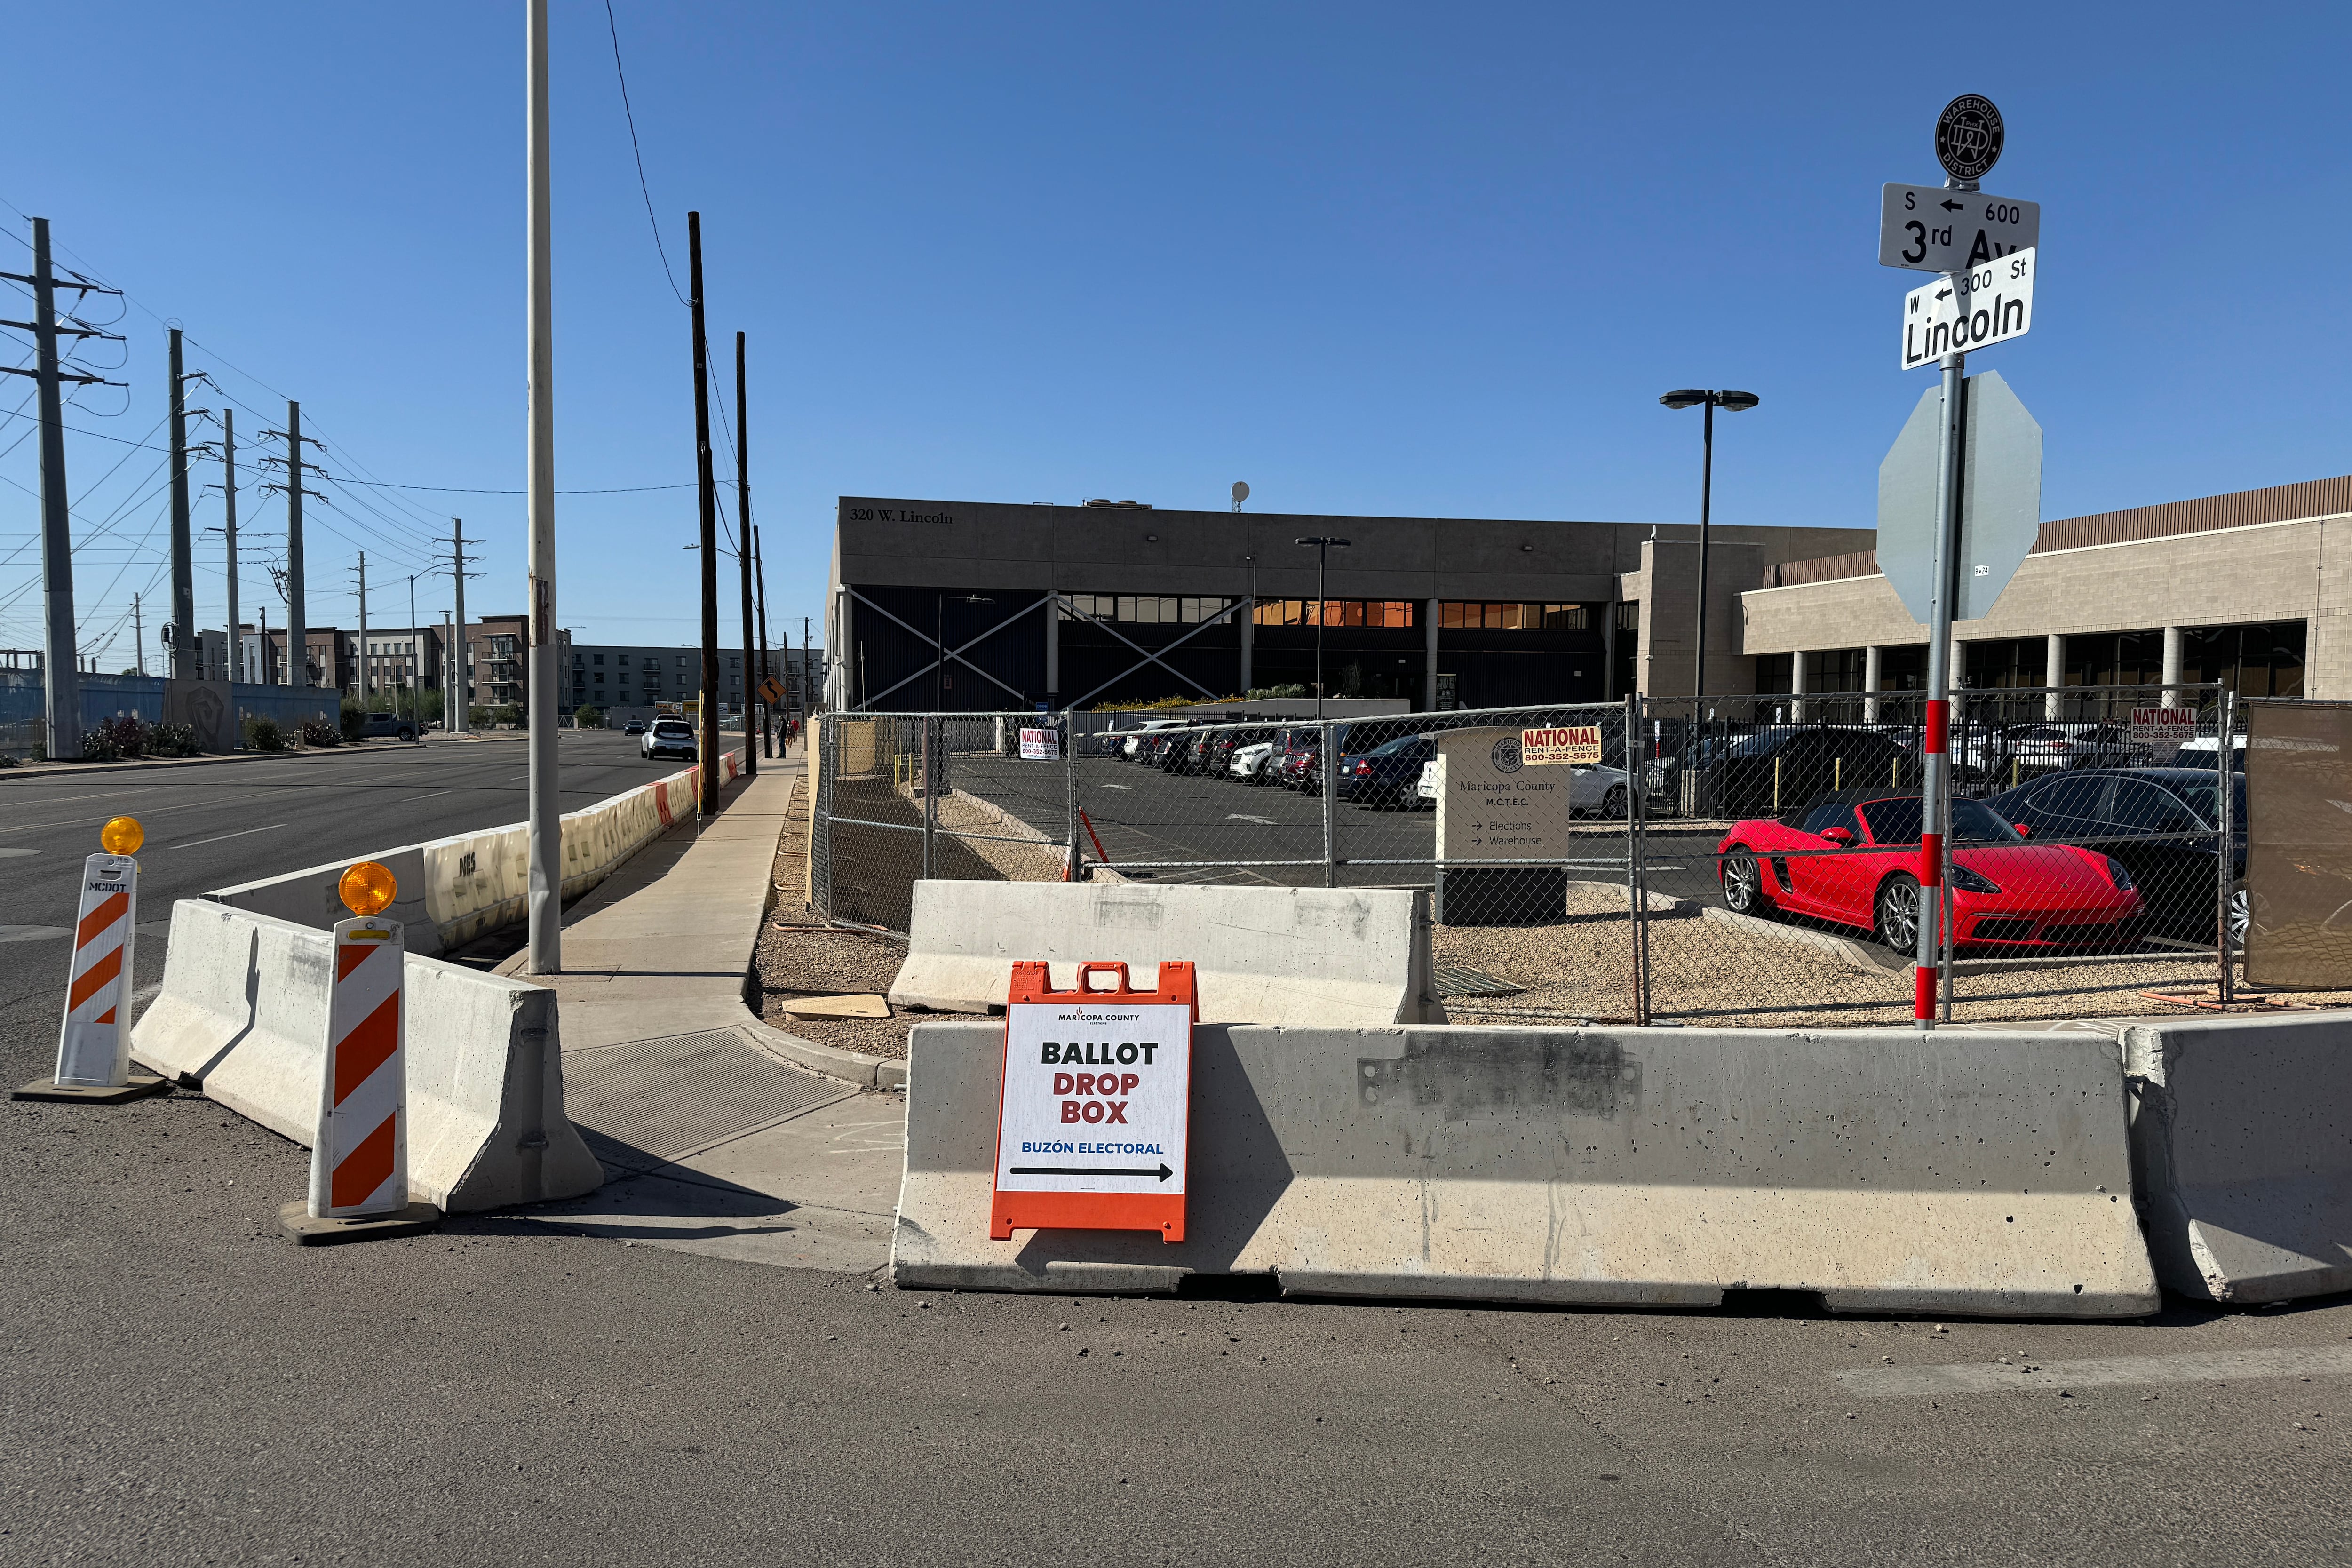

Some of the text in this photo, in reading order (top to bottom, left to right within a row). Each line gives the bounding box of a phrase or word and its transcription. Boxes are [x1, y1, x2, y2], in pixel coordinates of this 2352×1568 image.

[1943, 99, 2000, 134] WAREHOUSE
[1943, 152, 1988, 175] DISTRICT
[1905, 191, 2019, 224] S 600
[1902, 220, 1952, 263] 3rd
[1910, 257, 2026, 313] W 300 St
[1907, 293, 2023, 364] Lincoln
[850, 509, 953, 524] 320 W. Lincoln
[2133, 709, 2195, 725] NATIONAL
[1022, 730, 1057, 744] NATIONAL
[1524, 728, 1599, 747] NATIONAL
[1525, 752, 1599, 761] 800-352-5675
[1460, 781, 1555, 793] Maricopa County
[1490, 821, 1532, 831] Elections
[1489, 836, 1542, 845] Warehouse
[460, 852, 476, 877] NES
[89, 882, 127, 893] MCDOT
[1058, 1010, 1103, 1021] MARICOPA
[1041, 1042, 1158, 1065] BALLOT
[1053, 1073, 1139, 1095] DROP
[1061, 1101, 1128, 1124] BOX
[1022, 1139, 1164, 1154] BUZÓN ELECTORAL
